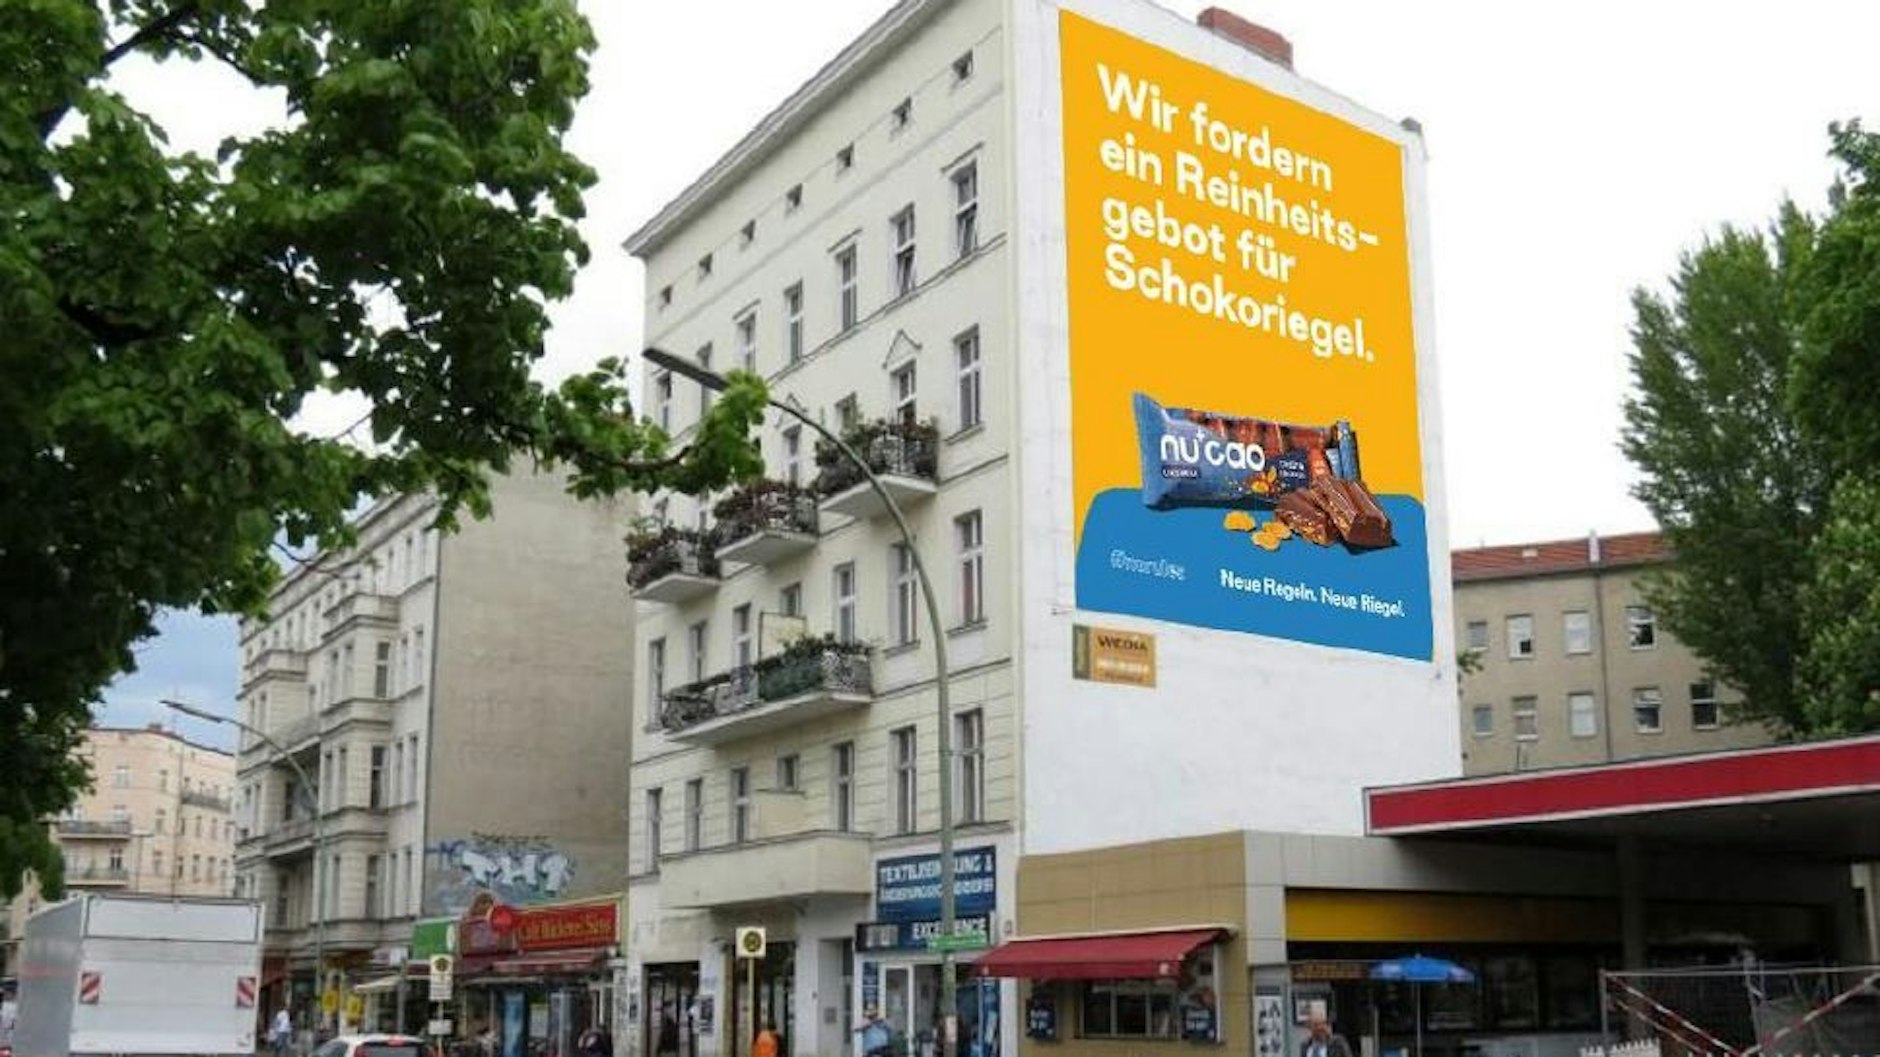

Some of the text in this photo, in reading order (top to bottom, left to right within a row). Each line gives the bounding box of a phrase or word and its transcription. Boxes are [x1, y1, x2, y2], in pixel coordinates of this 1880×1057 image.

[1097, 63, 1332, 190] Wir fordern
[1100, 133, 1378, 251] ein Reinheits-
[1102, 197, 1296, 282] gebot für
[1104, 243, 1374, 361] Schokoriegel.
[1220, 569, 1405, 618] Neue Regeln. Neue Riegel.
[911, 918, 987, 940] EXCEENCE
